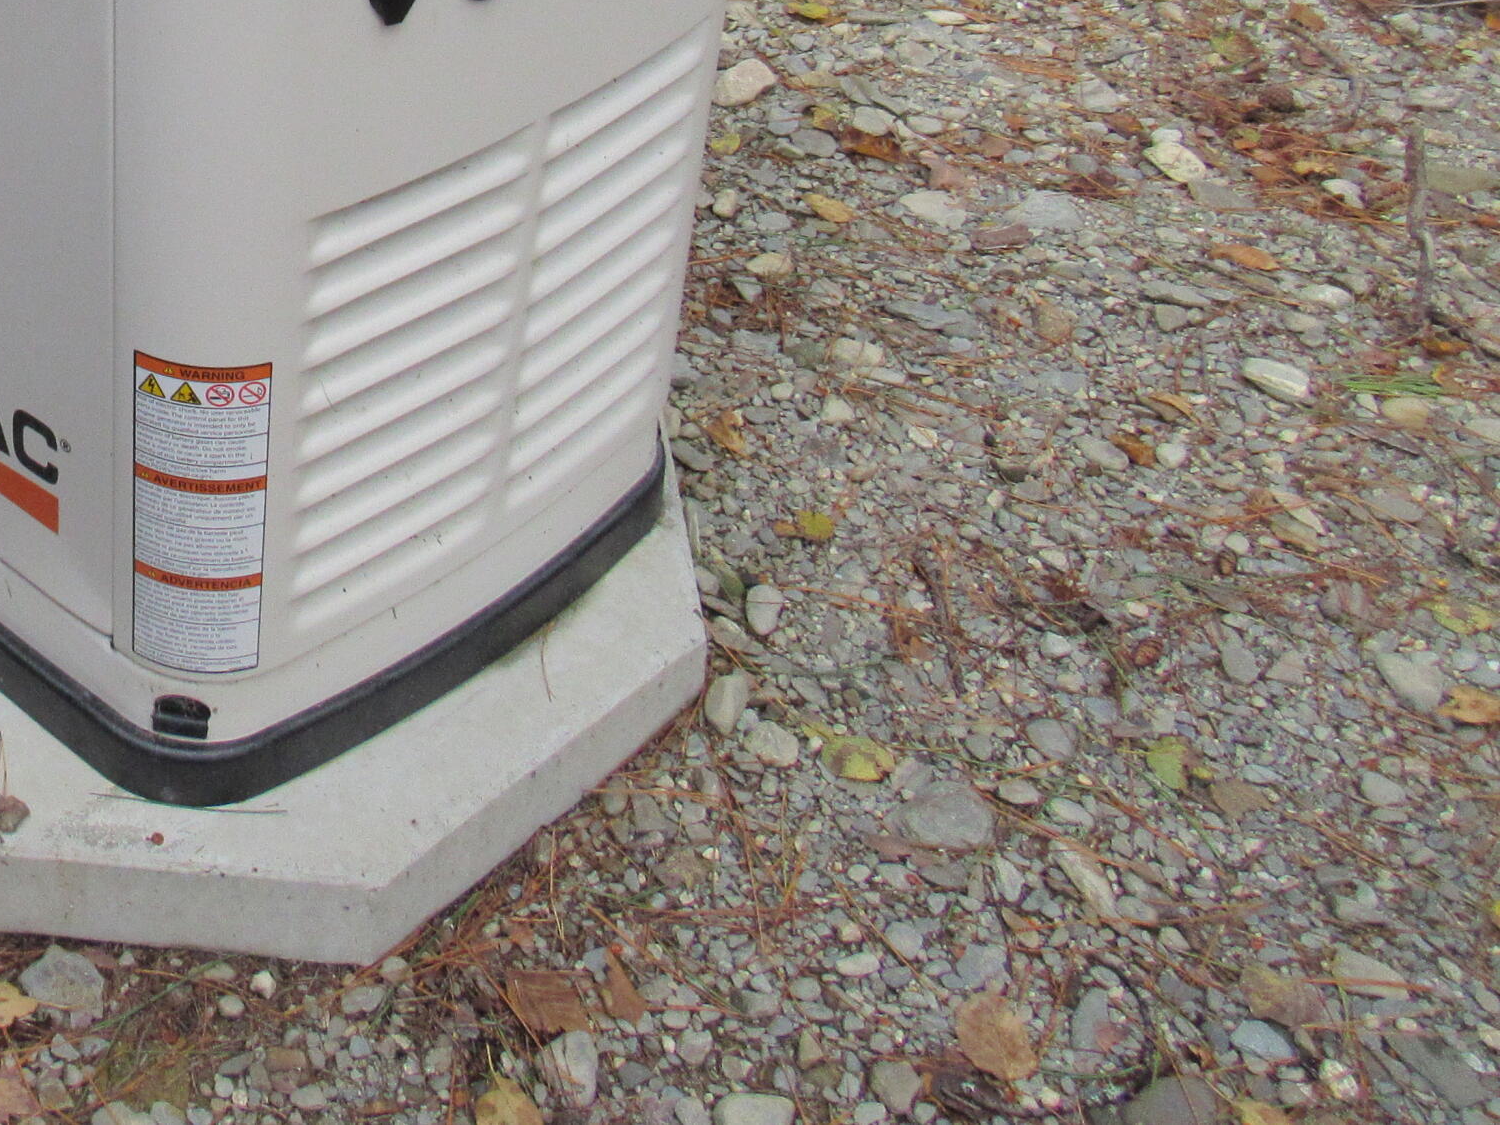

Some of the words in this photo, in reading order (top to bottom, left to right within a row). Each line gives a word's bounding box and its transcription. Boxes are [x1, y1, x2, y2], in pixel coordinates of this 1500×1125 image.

[179, 368, 245, 381] WARNING
[153, 475, 262, 493] AVERTISSEMENT
[160, 574, 251, 590] ADVERTENCIA
